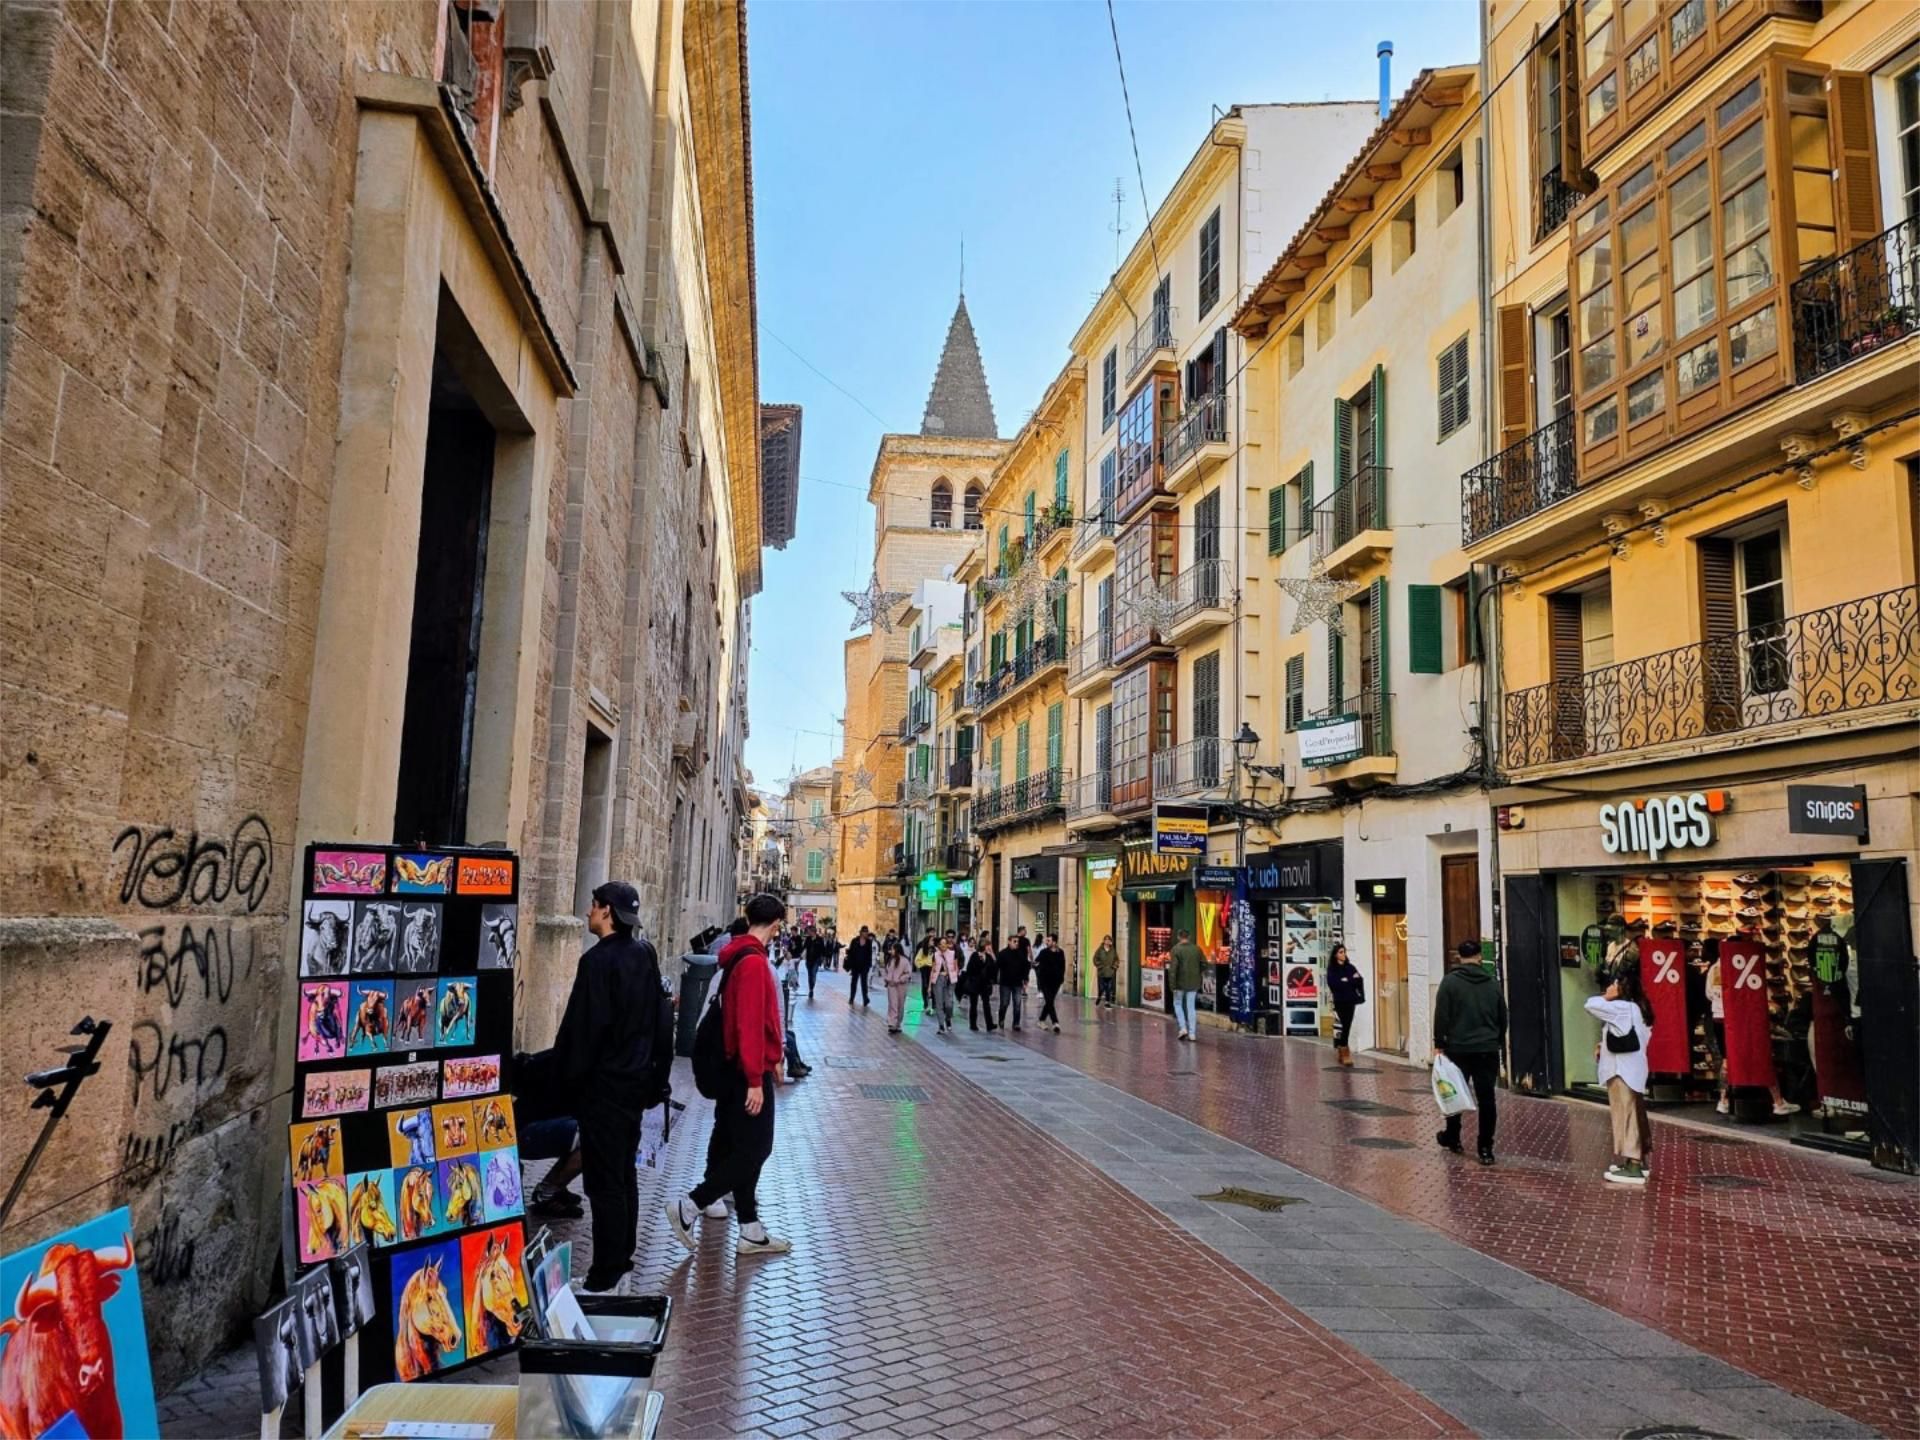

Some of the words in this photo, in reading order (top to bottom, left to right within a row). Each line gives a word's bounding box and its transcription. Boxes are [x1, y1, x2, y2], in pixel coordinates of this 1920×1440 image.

[1599, 788, 1711, 861] snipes
[1806, 800, 1855, 823] snipes
[1651, 950, 1680, 984] %
[1731, 953, 1763, 990] %
